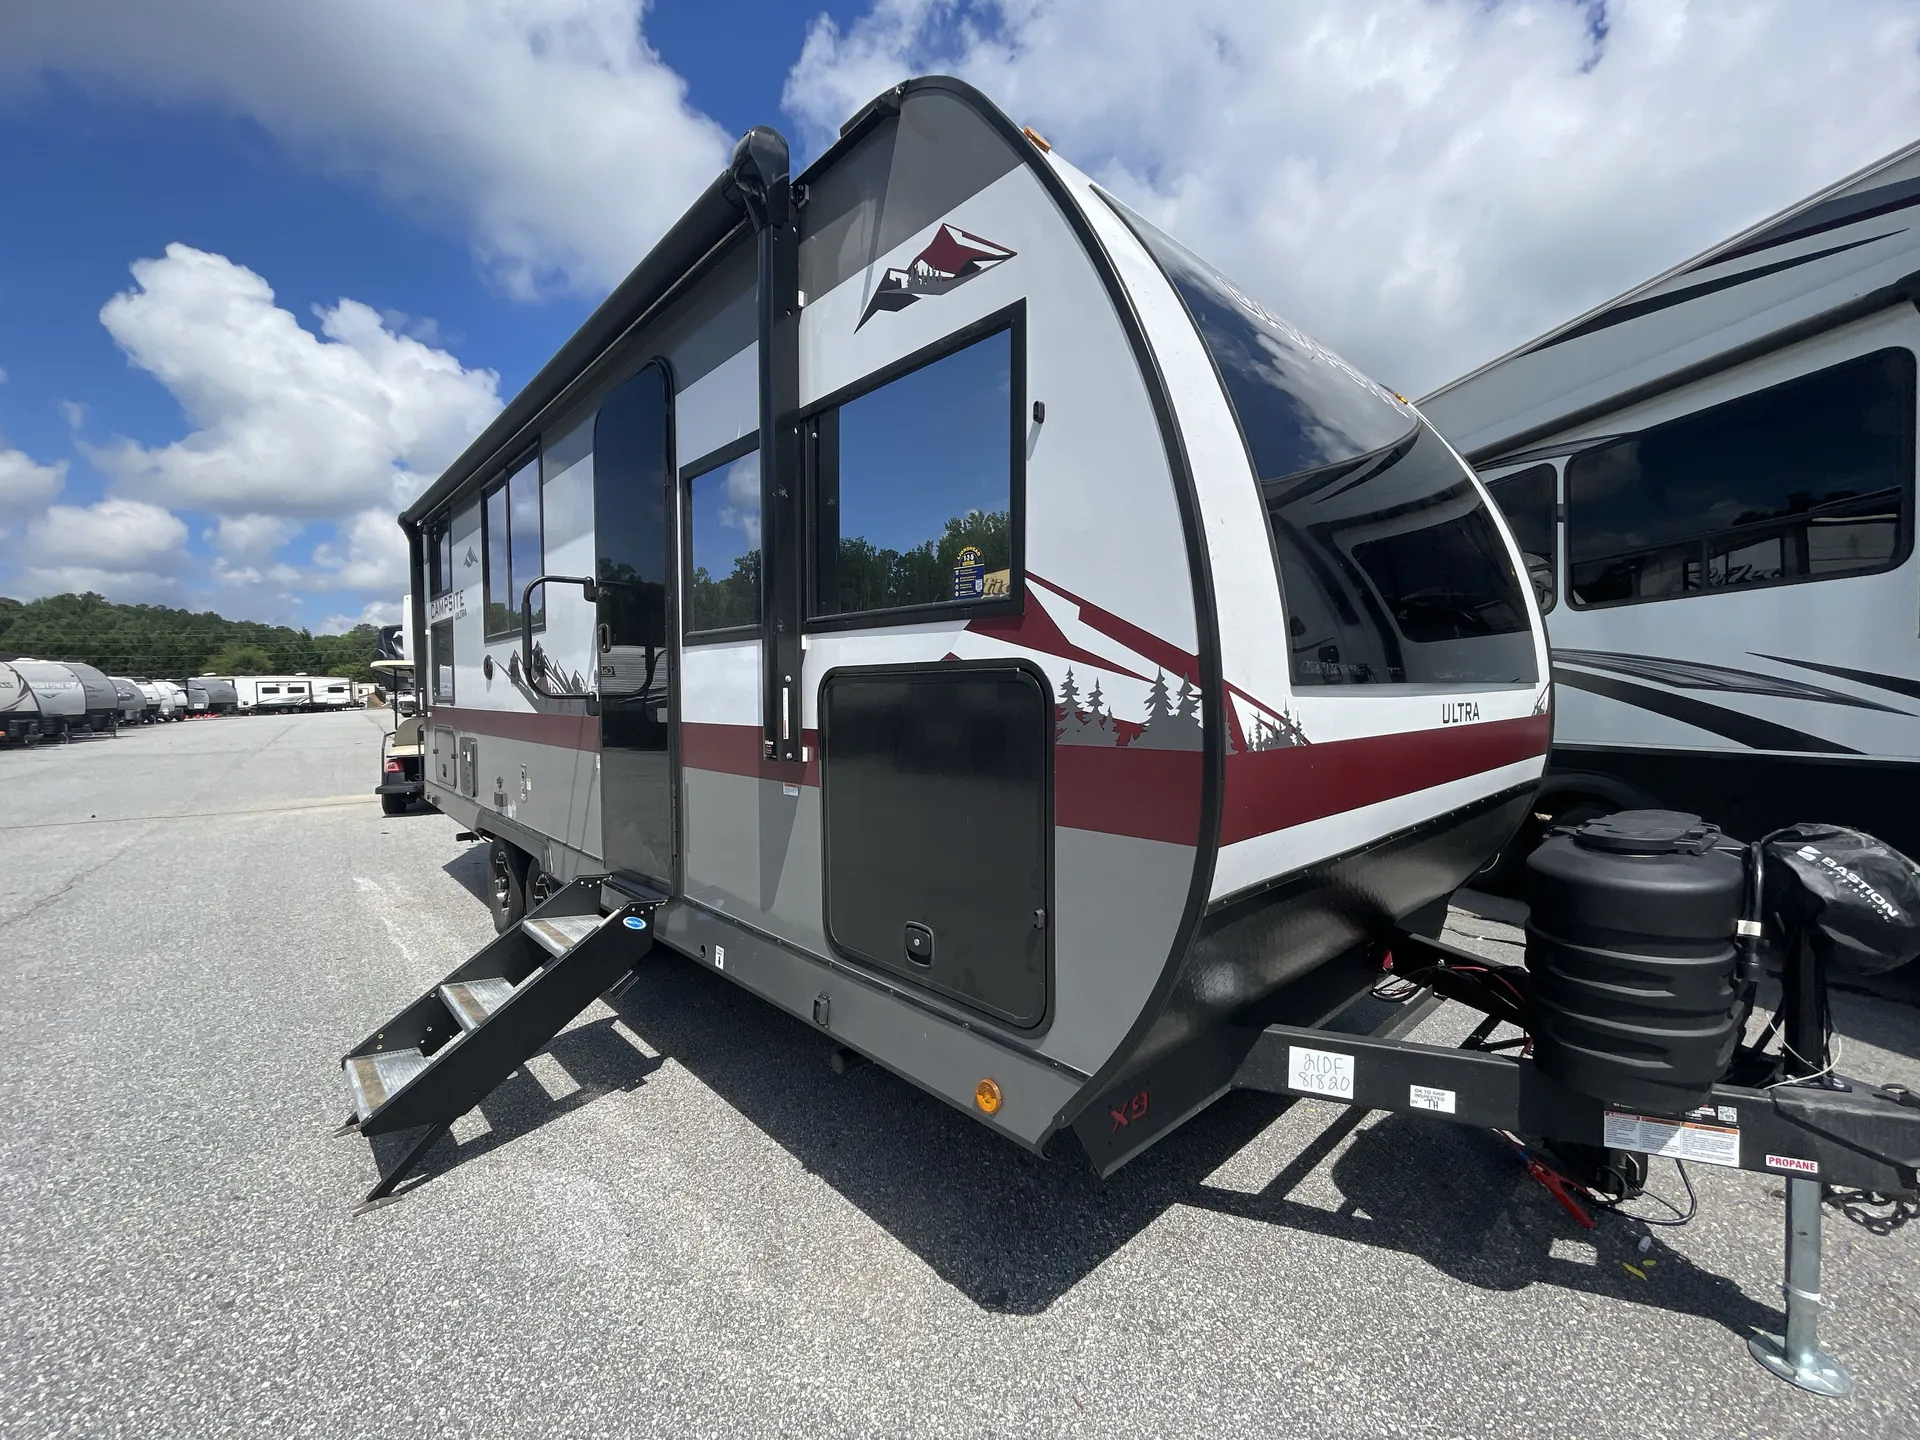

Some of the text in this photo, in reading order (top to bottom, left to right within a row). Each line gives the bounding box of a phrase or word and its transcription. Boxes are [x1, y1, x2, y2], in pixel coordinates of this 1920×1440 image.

[431, 589, 464, 619] CAMPSITE
[1442, 702, 1480, 724] ULTRA
[1821, 857, 1899, 917] BASTION
[1303, 1053, 1344, 1075] 21DF
[1298, 1071, 1350, 1092] 81820
[1414, 1093, 1445, 1102] INSPECTED
[1768, 1156, 1817, 1172] PROPANE
